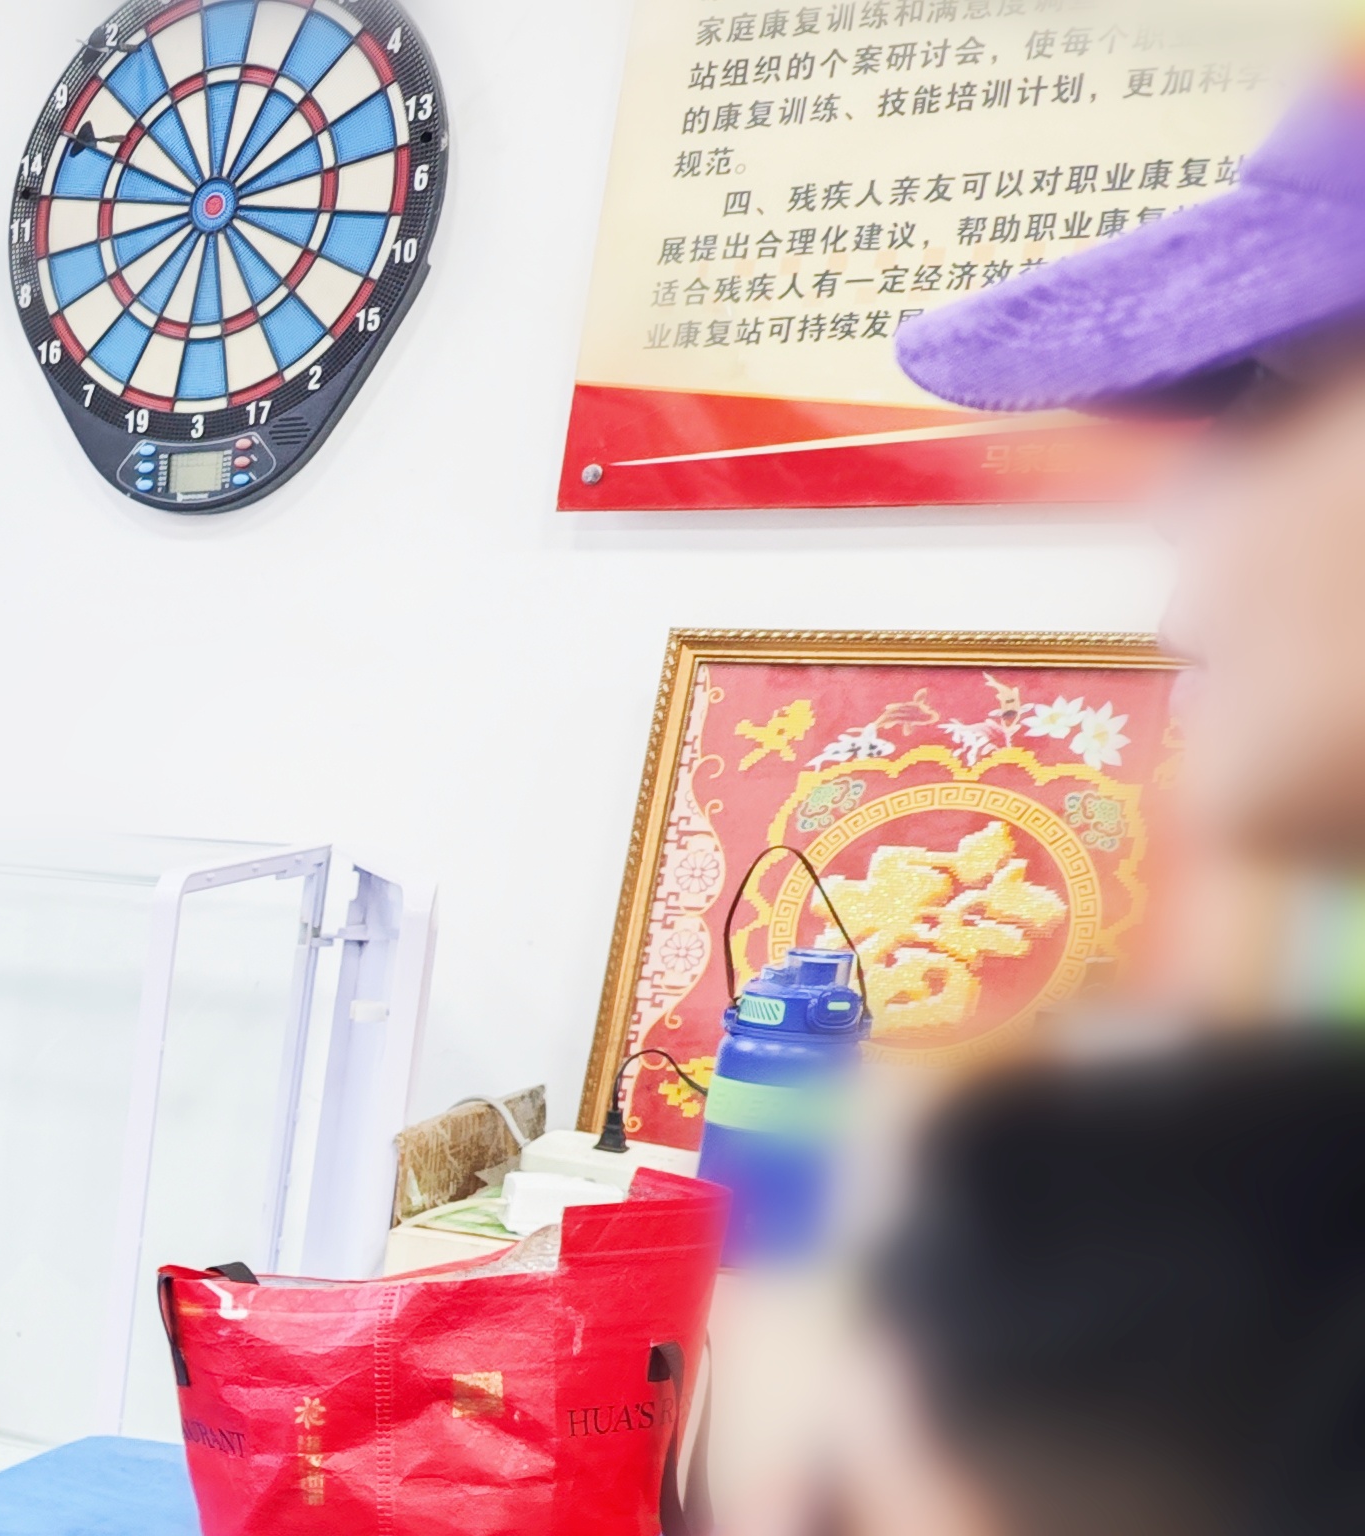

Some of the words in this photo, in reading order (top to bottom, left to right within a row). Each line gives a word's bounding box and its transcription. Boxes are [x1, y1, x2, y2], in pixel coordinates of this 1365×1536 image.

[387, 26, 402, 53] 4
[54, 84, 68, 109] 9
[406, 93, 434, 121] 13
[21, 153, 42, 177] 14
[414, 164, 429, 191] 6
[11, 218, 31, 244] 11
[393, 238, 417, 263] 10
[18, 284, 32, 309] 8
[356, 307, 380, 332] 15
[38, 340, 61, 364] 16
[308, 366, 322, 390] 2
[83, 384, 95, 408] 7
[125, 410, 149, 434] 19
[246, 401, 270, 425] 17
[191, 415, 204, 438] 3
